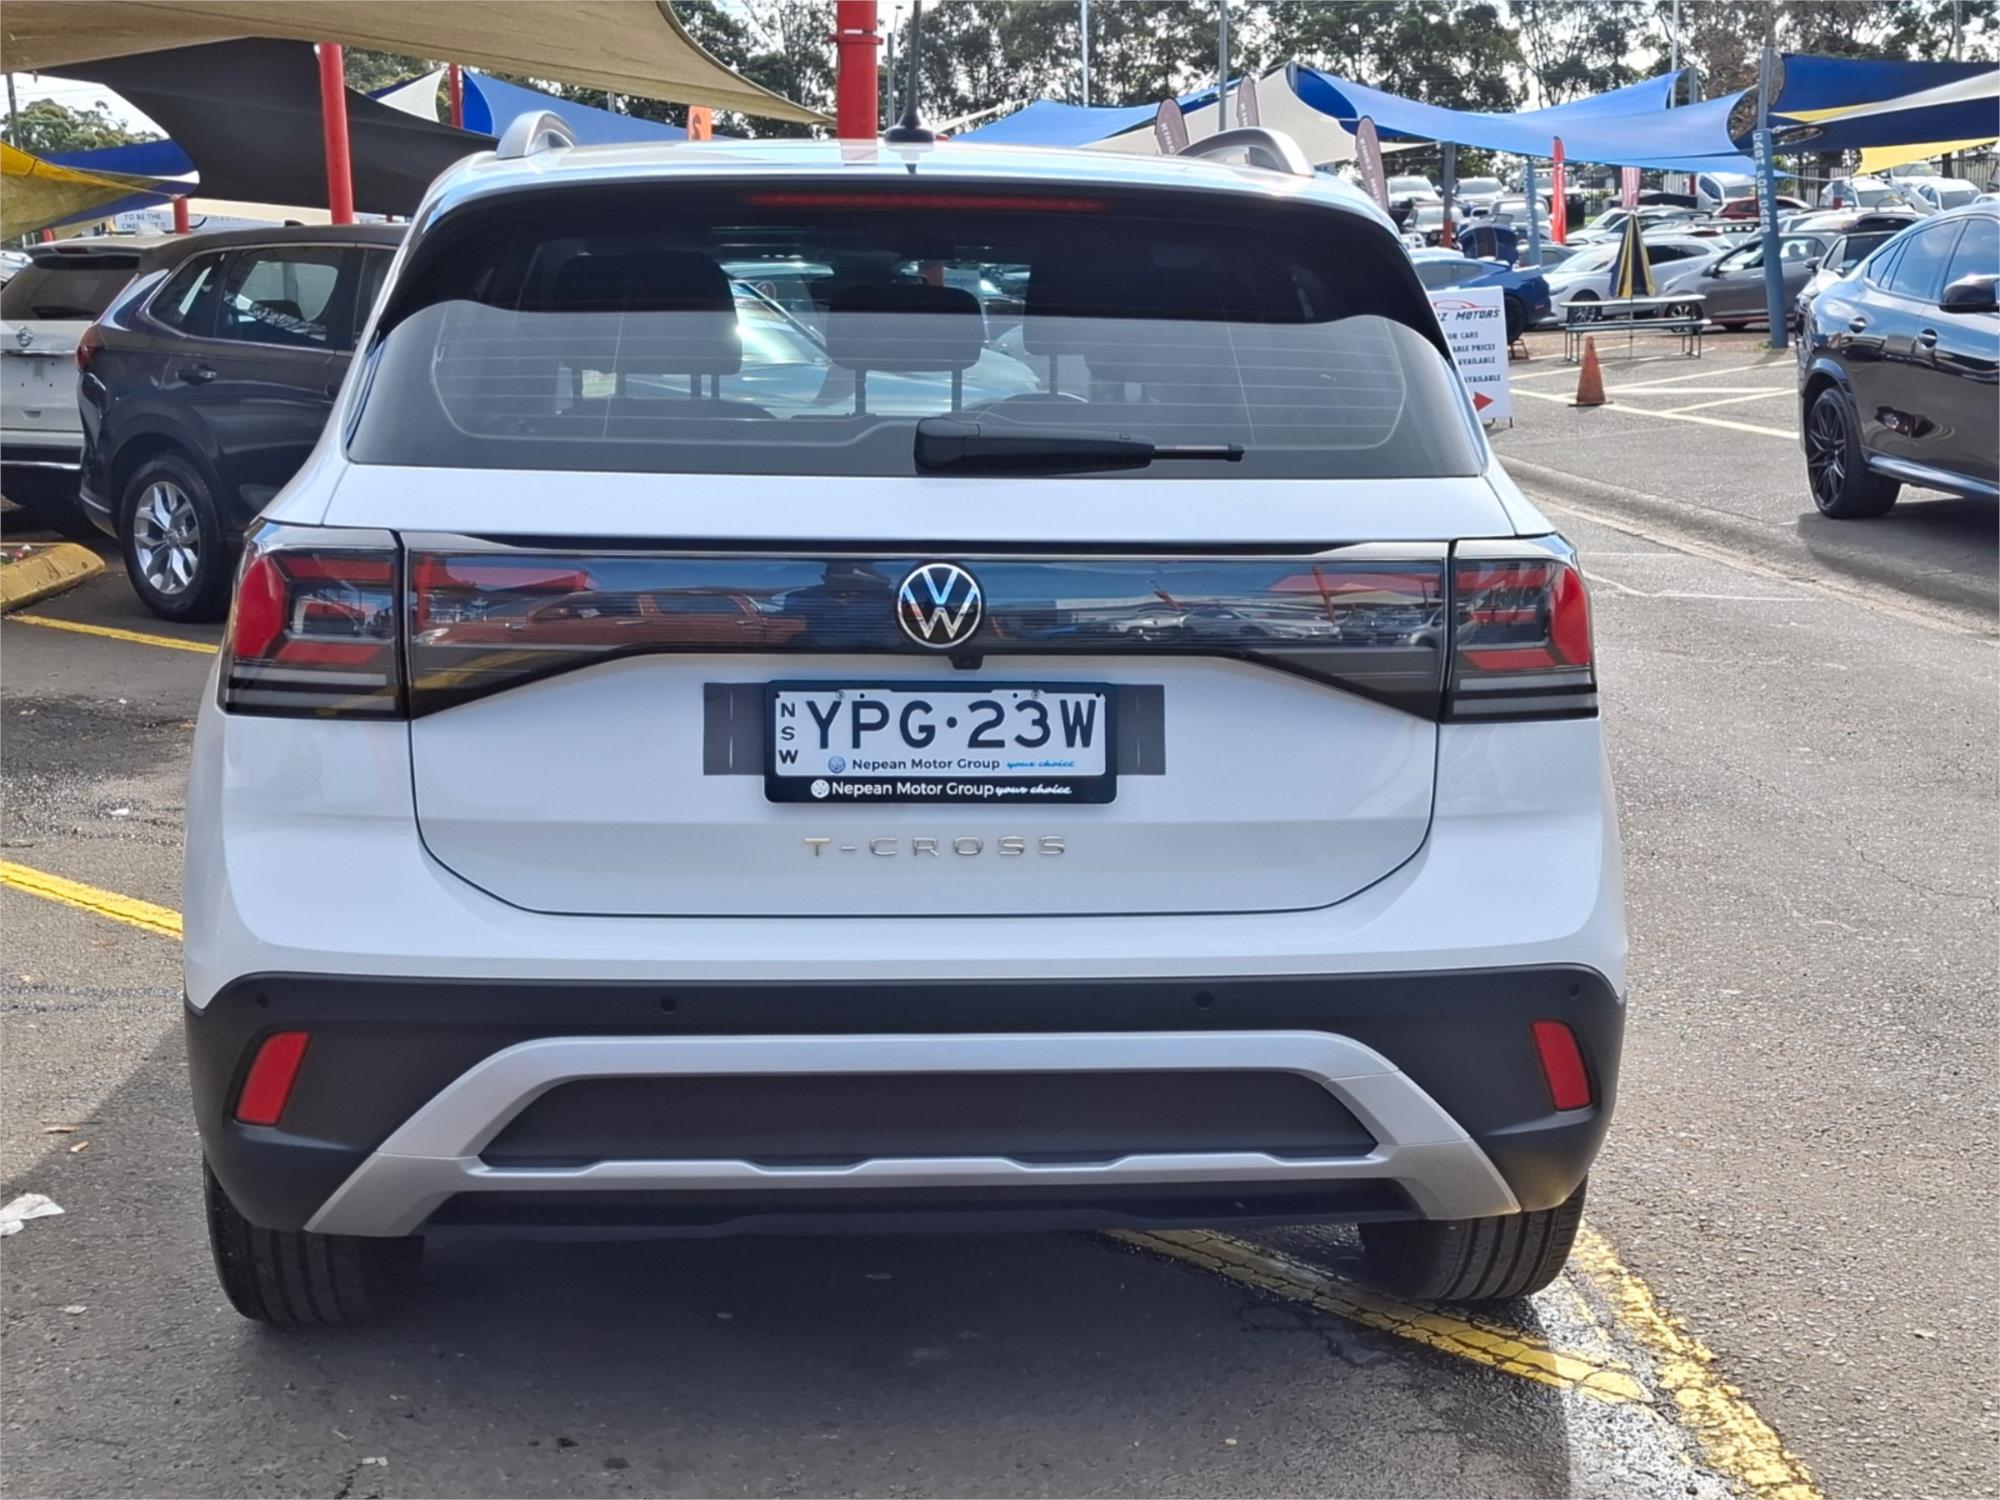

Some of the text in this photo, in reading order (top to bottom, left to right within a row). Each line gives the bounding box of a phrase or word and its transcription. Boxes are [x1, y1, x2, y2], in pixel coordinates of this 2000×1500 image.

[1753, 132, 1771, 233] CASH FOR CARS
[1455, 309, 1500, 320] MOTORS
[1460, 331, 1479, 340] CARS
[1471, 344, 1496, 352] PRICES
[1458, 356, 1496, 366] AVAILABLE
[852, 758, 906, 772] Nepean
[911, 758, 953, 770] Motor
[957, 758, 1001, 771] Group
[1038, 759, 1075, 768] choice
[832, 781, 1072, 798] Nepean Motor Group your choice
[803, 836, 1066, 858] T-CROSS
